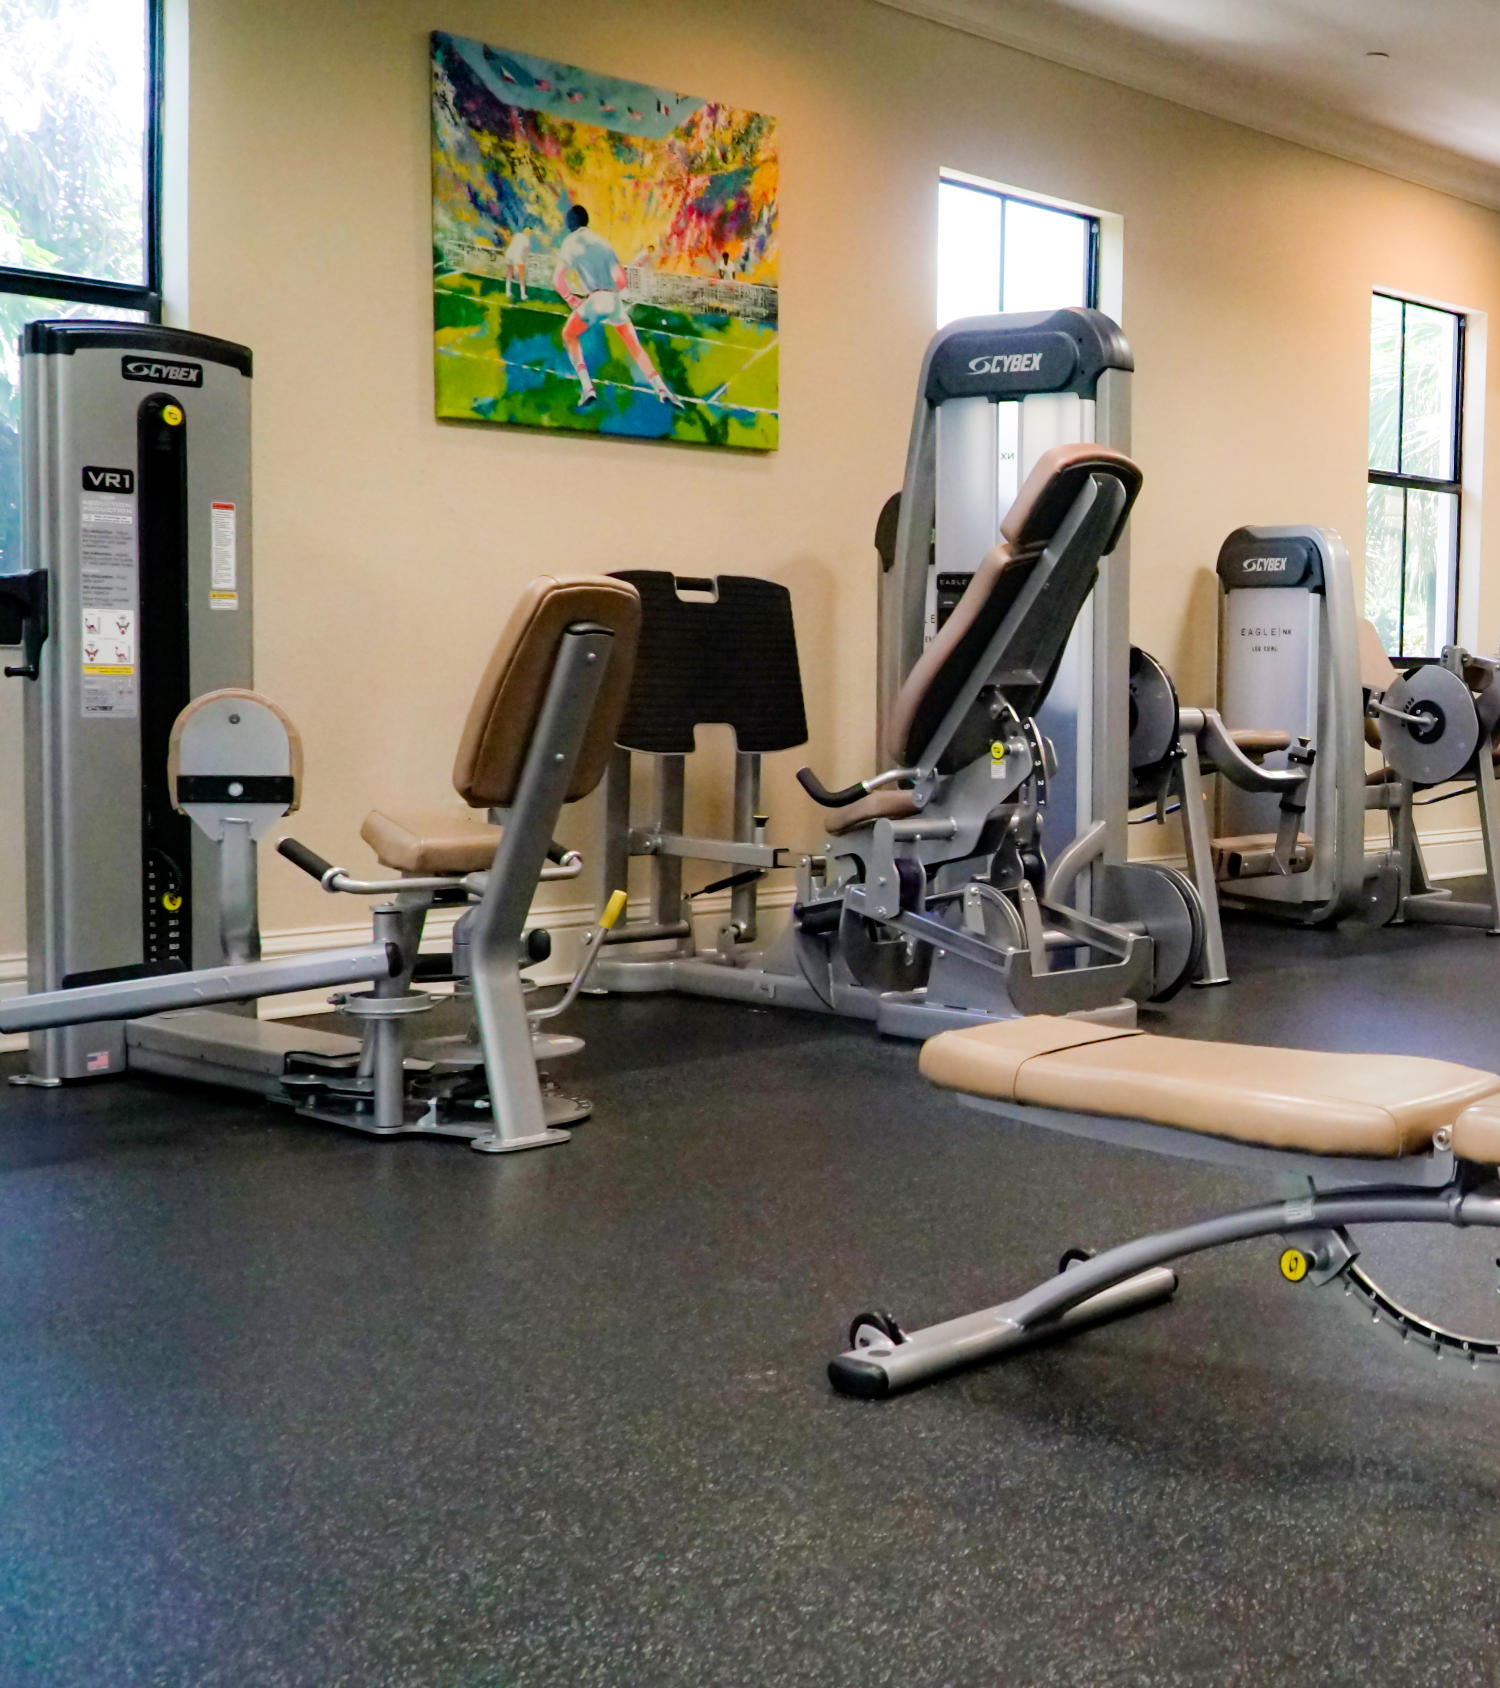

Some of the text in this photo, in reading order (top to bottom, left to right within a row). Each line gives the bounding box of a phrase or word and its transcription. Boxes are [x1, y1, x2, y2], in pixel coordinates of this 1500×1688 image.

[989, 352, 1043, 374] CYBEX
[149, 363, 200, 383] CYBEX
[87, 471, 131, 489] VR1
[1256, 557, 1288, 571] CYBEX
[1240, 627, 1277, 637] EAGLE
